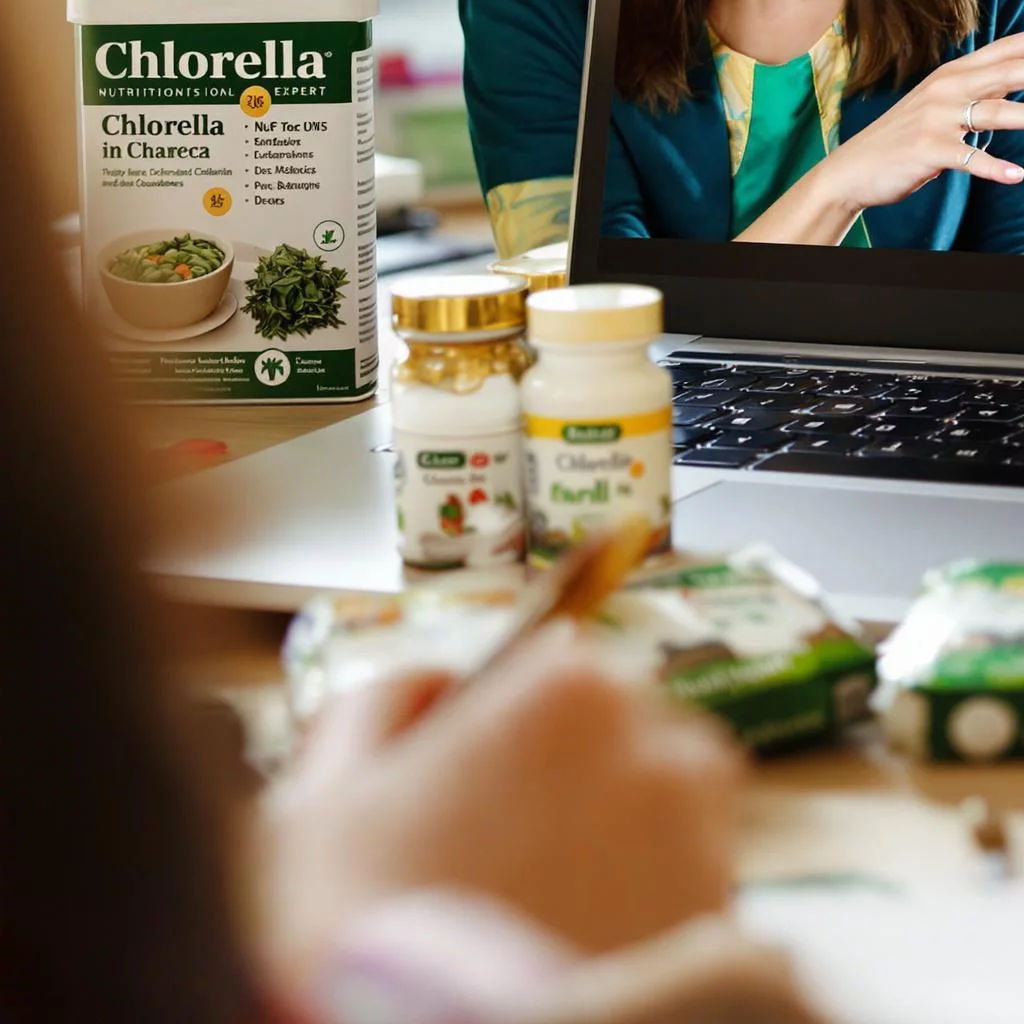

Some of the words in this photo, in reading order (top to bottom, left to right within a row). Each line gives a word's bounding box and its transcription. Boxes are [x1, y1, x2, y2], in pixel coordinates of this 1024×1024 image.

[95, 39, 327, 80] Chlorella
[274, 86, 327, 98] EXPERT
[101, 113, 225, 136] Chlorella
[102, 141, 122, 158] in
